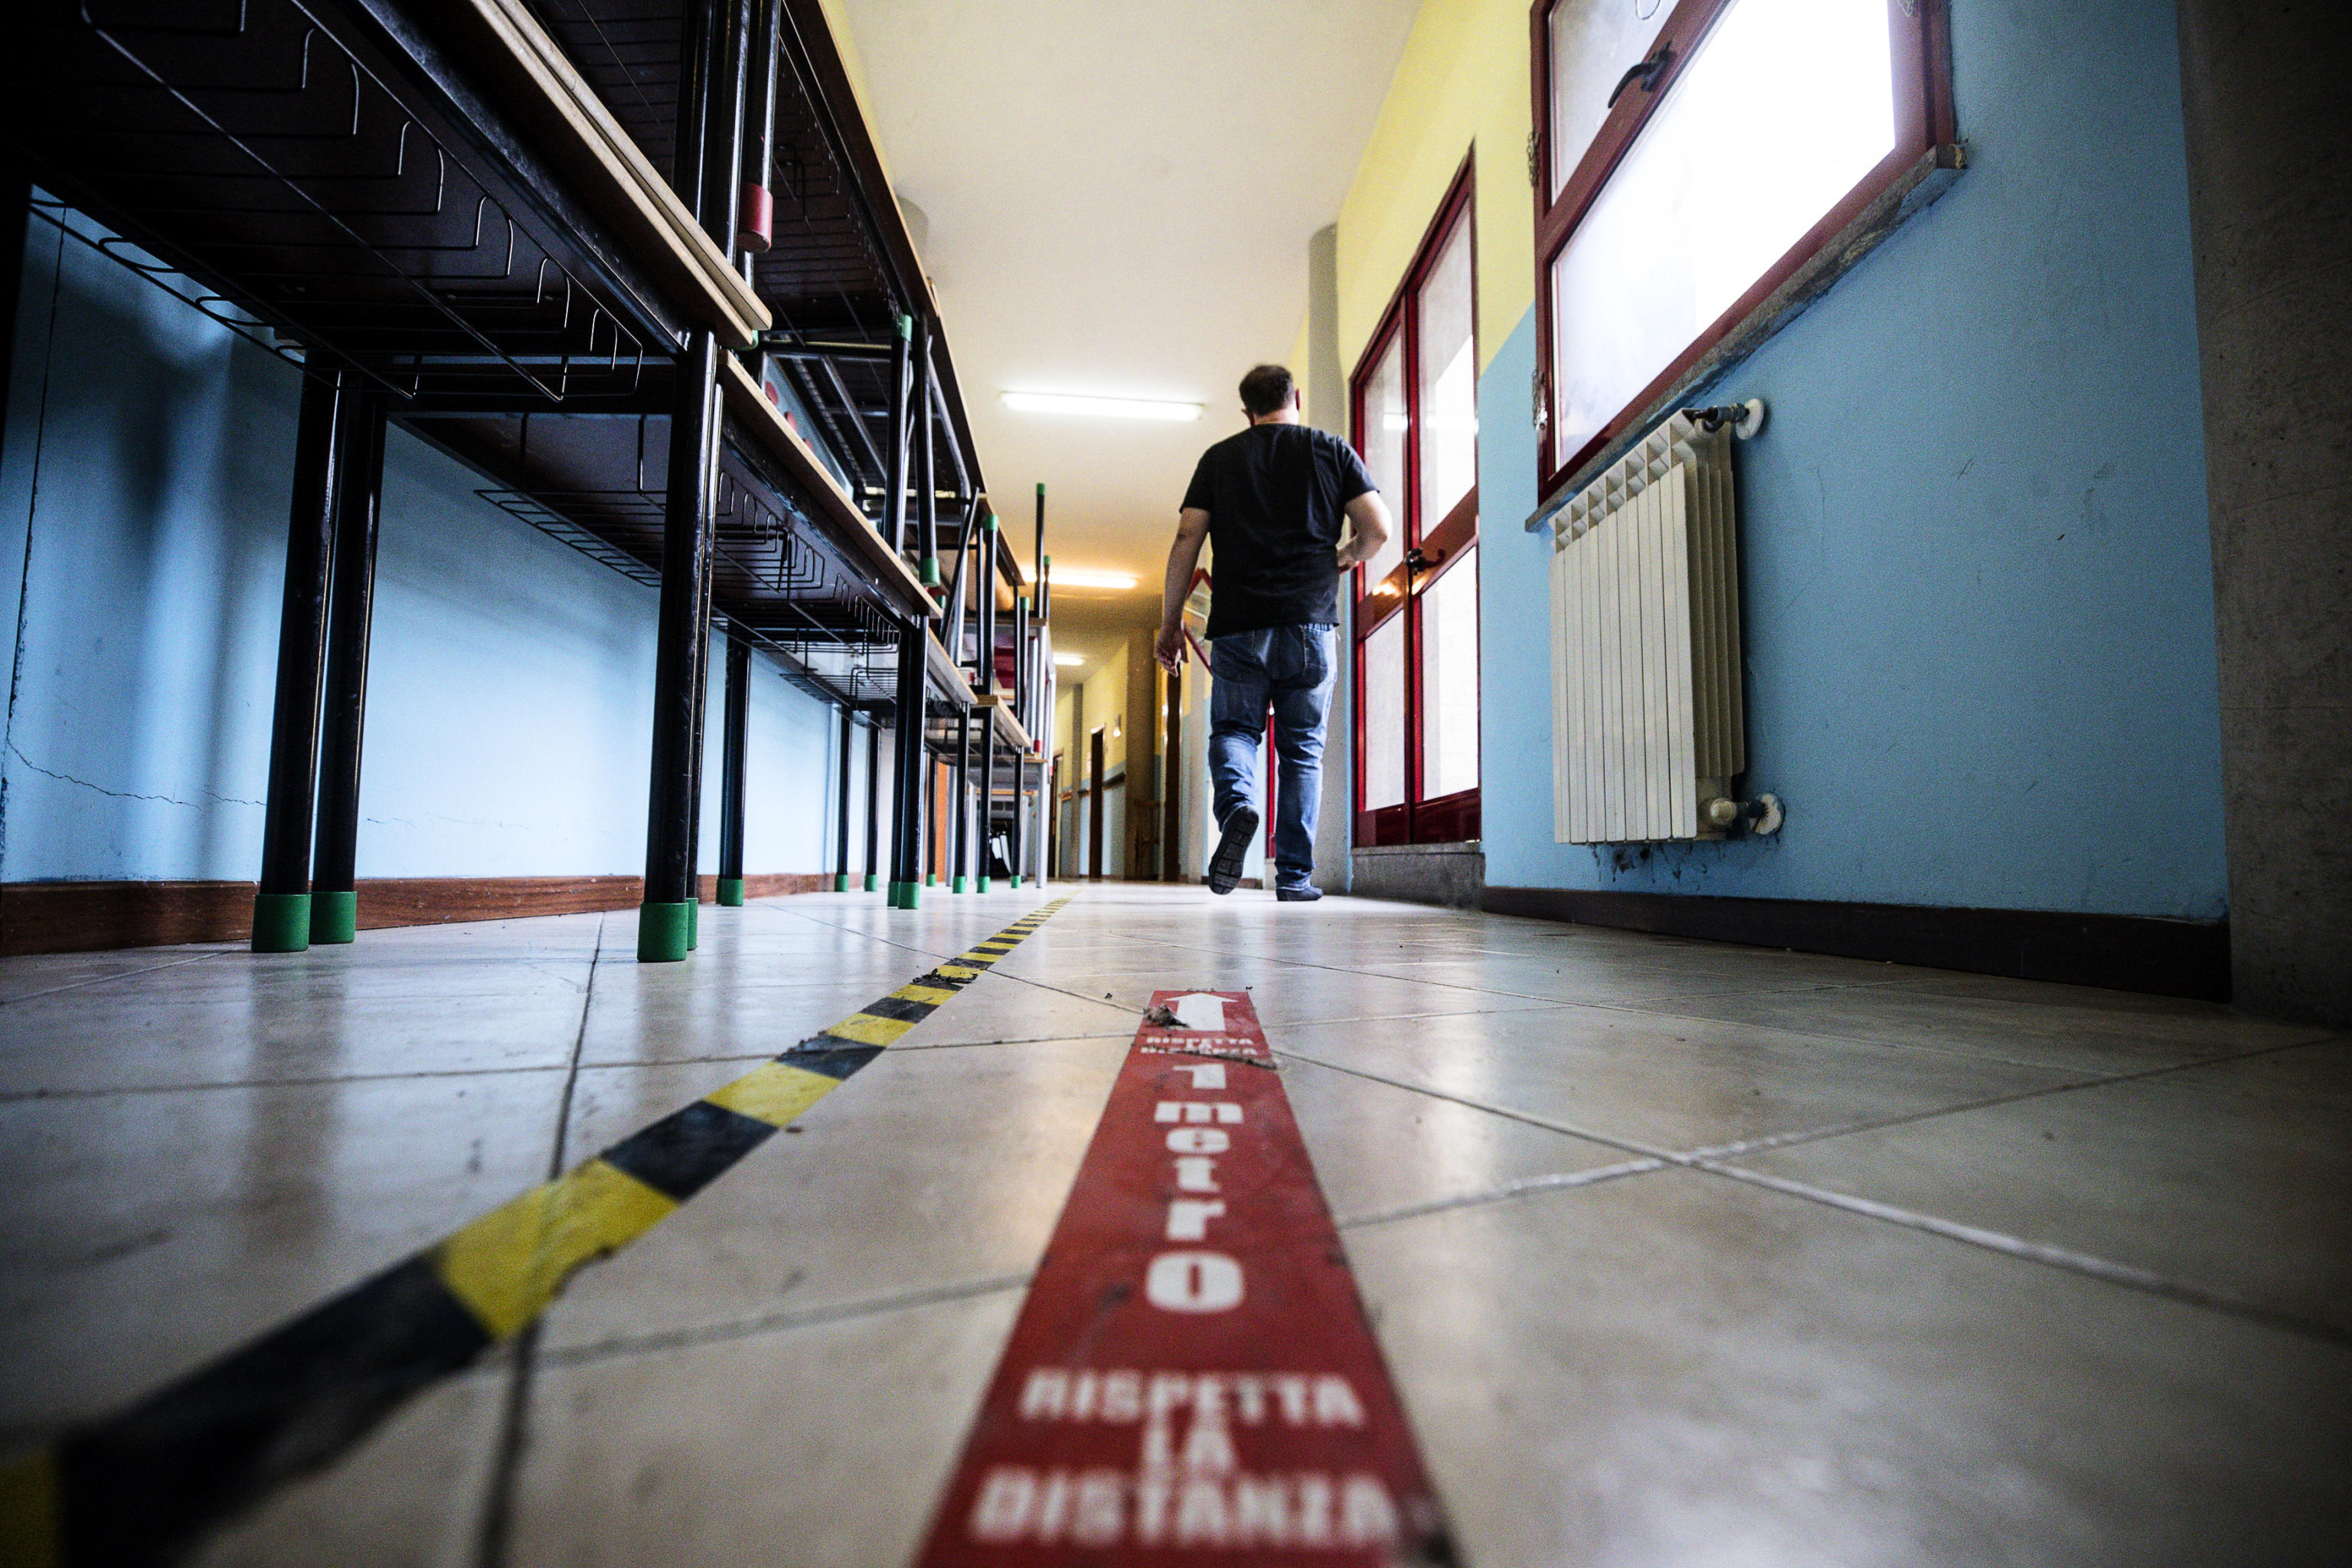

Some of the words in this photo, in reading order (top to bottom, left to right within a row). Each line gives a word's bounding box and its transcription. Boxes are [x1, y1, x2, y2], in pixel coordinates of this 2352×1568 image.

[1174, 1063, 1226, 1089] 1
[1020, 1369, 1364, 1426] RISPETTA
[1142, 1421, 1240, 1472] LA
[972, 1468, 1400, 1547] DISTANZA
